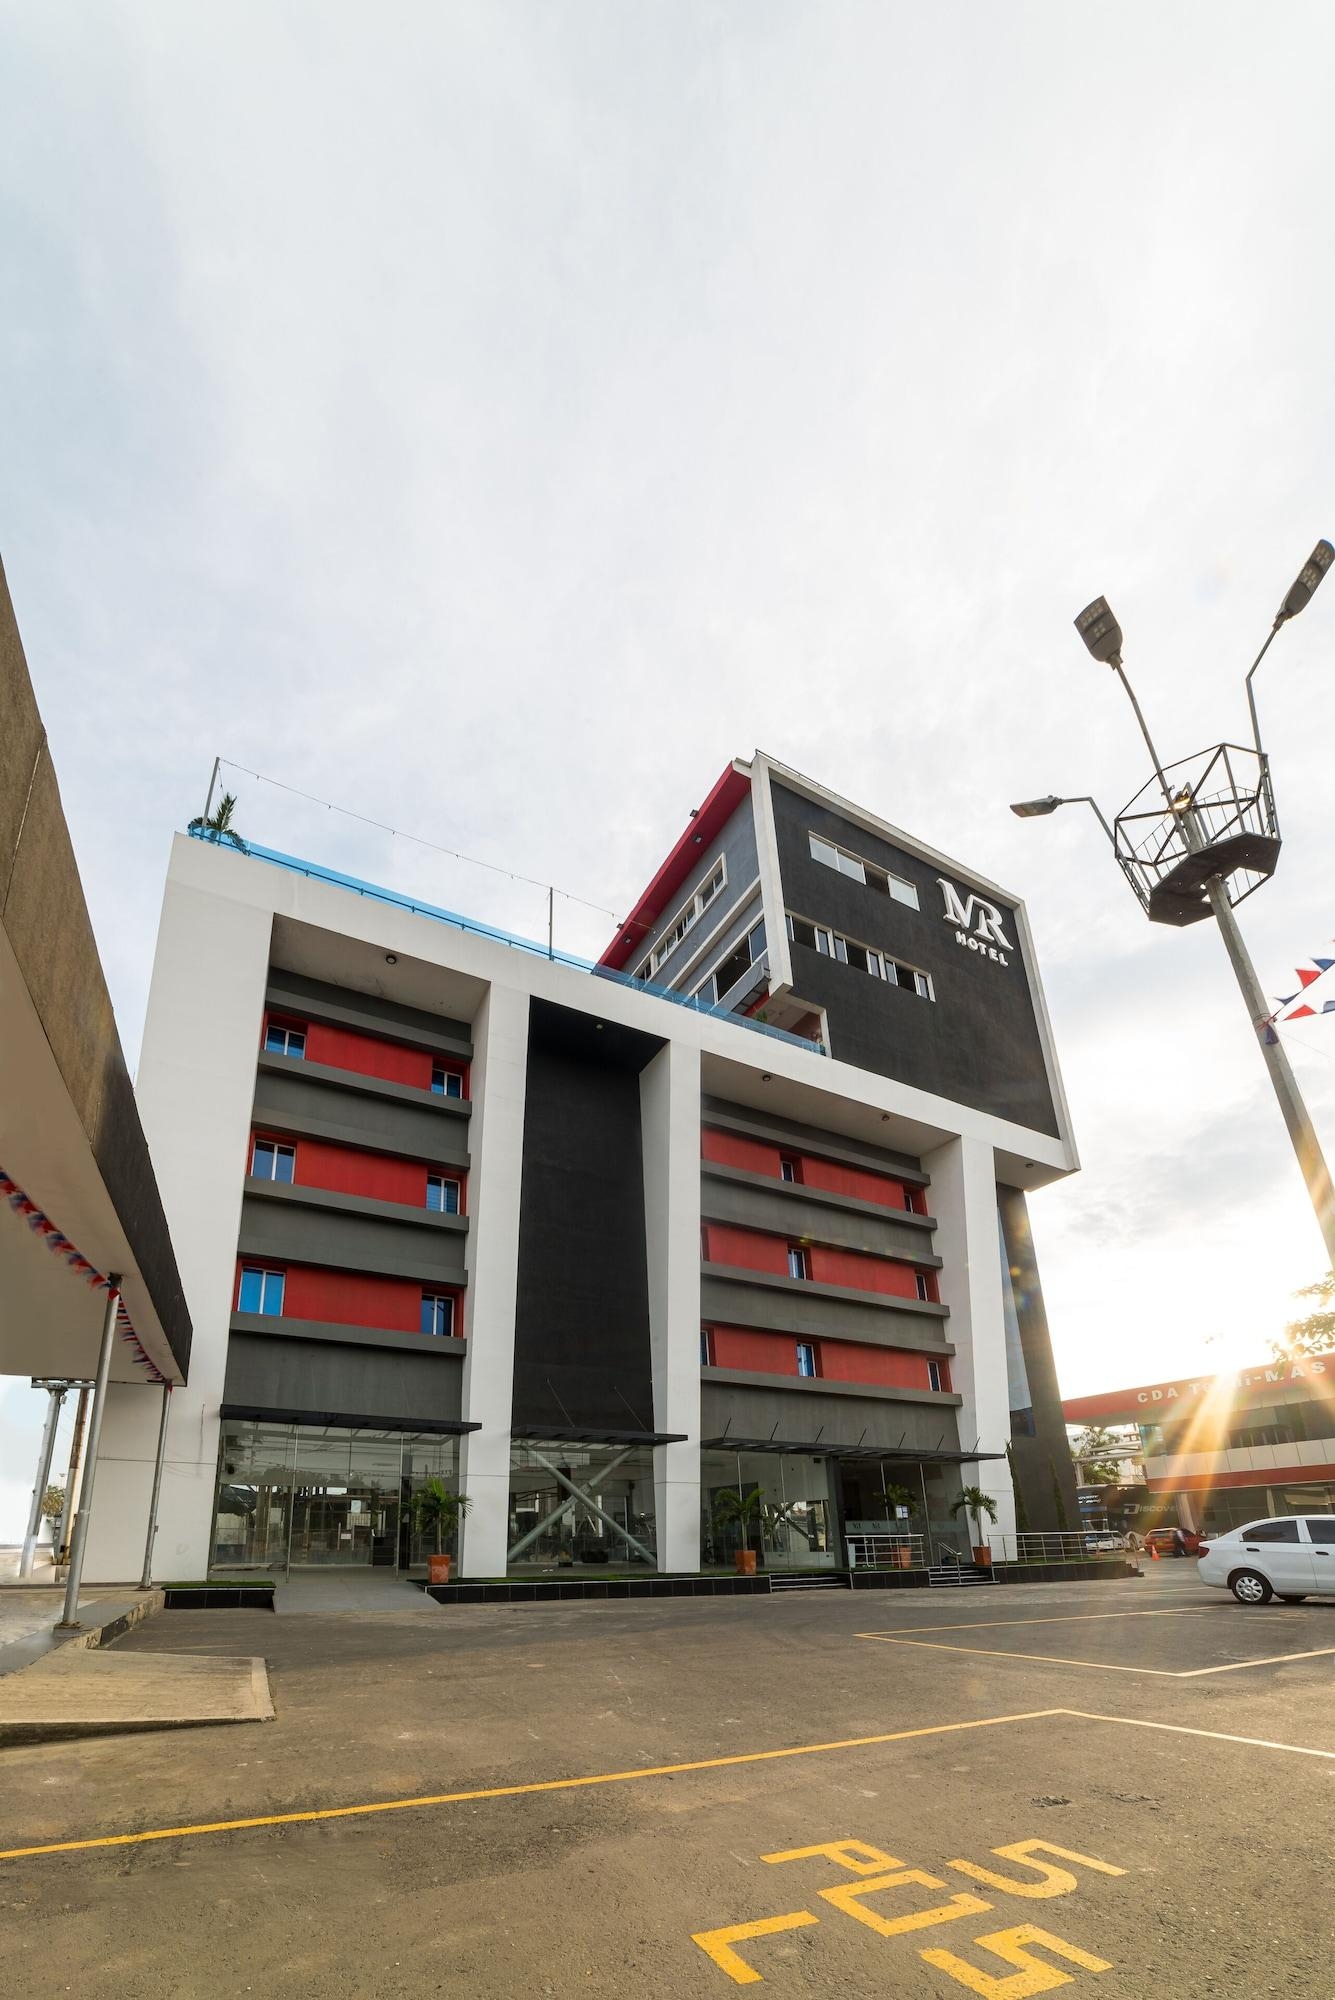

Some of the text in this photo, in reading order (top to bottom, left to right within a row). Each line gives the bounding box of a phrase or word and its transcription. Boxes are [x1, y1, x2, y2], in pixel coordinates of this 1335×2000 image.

[936, 878, 1014, 951] MR
[955, 930, 1009, 967] HOTEL
[1137, 1387, 1179, 1403] CDA
